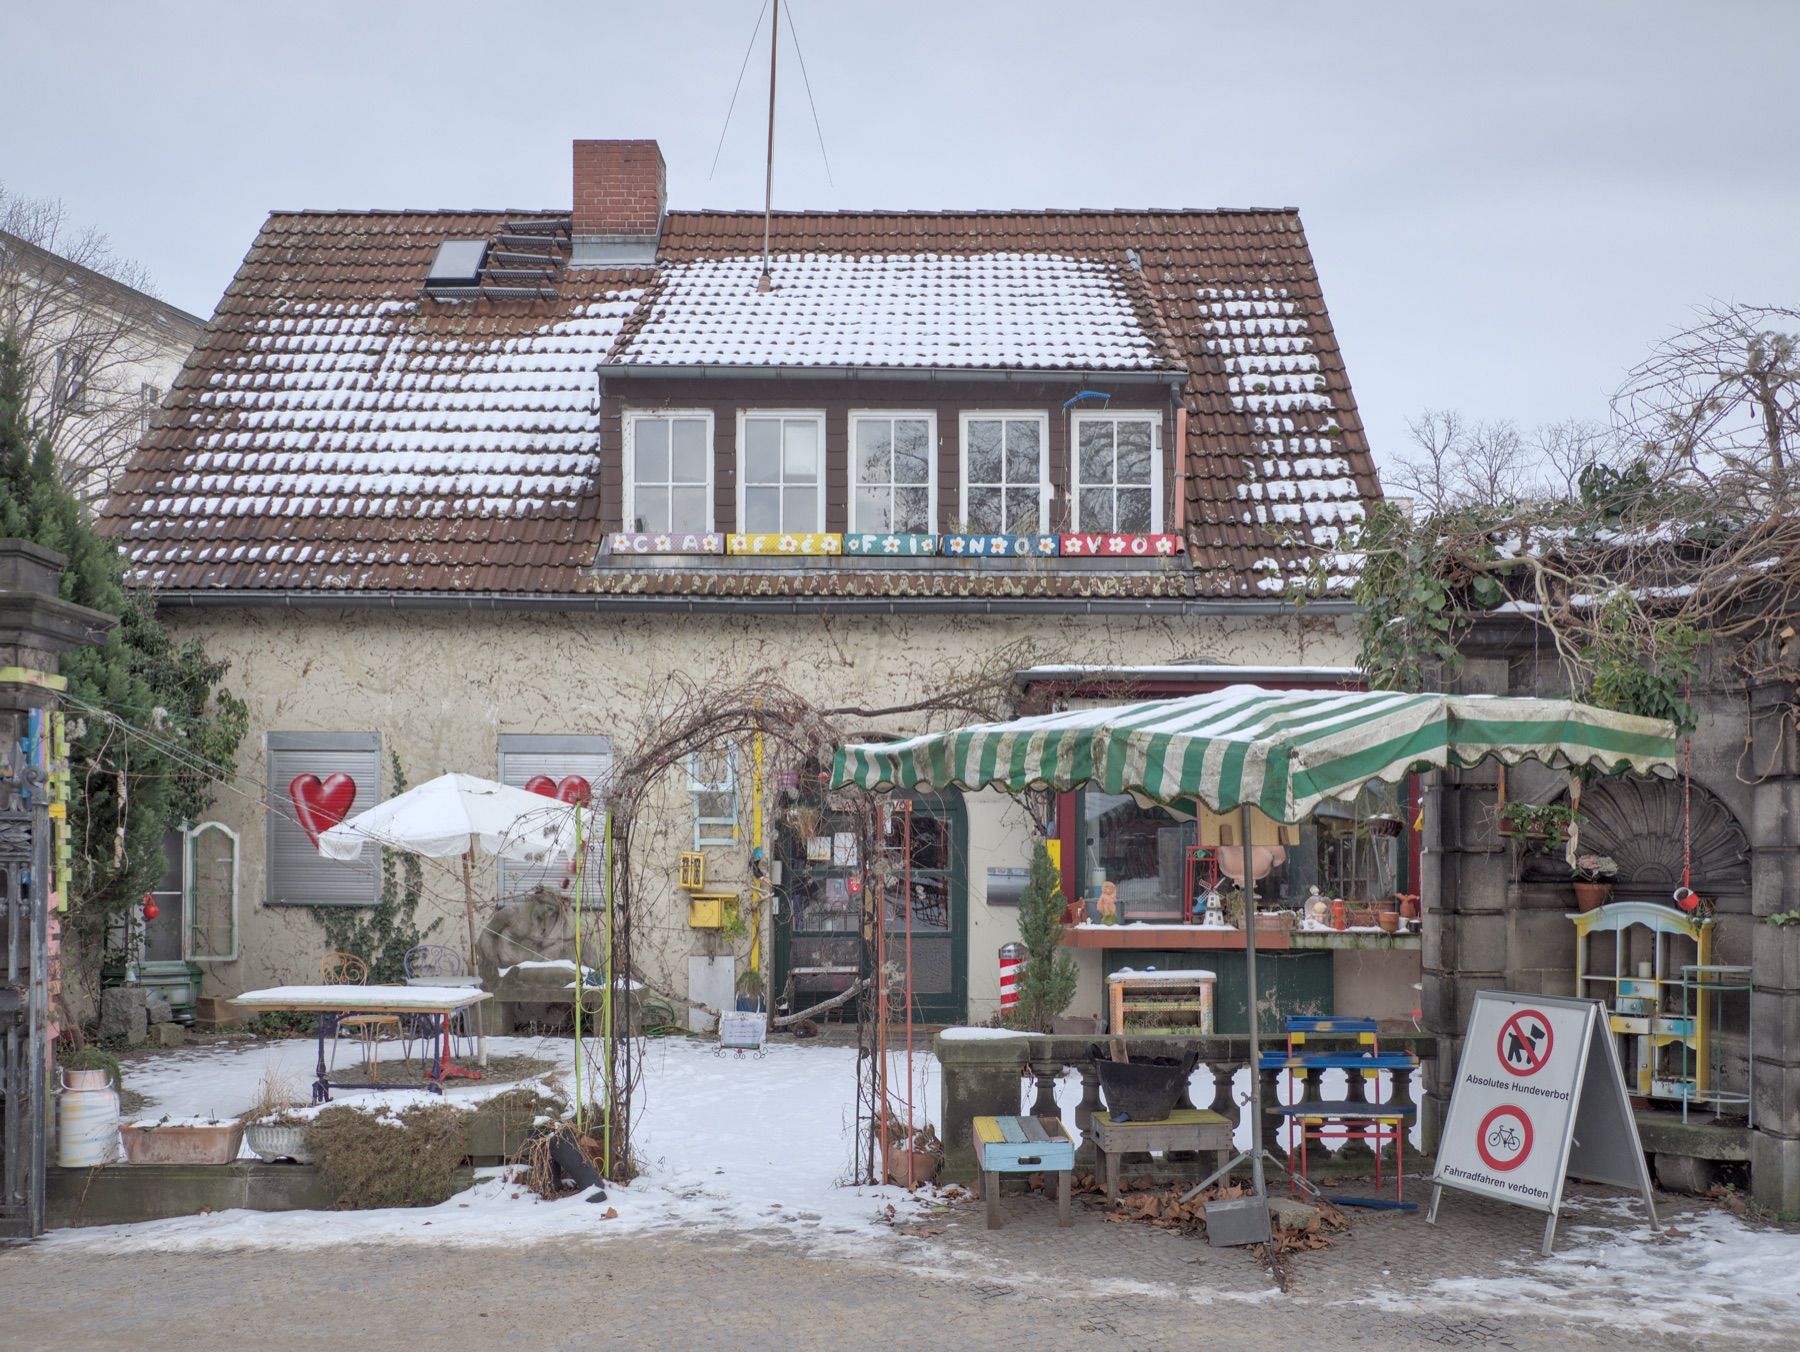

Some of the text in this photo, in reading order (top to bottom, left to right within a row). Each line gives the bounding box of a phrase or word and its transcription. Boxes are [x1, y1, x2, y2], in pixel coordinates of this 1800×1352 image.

[862, 534, 1148, 554] FINOVO
[1466, 1074, 1570, 1101] Absolutes Hundeverbot
[1443, 1165, 1549, 1199] Fahrradfahren verboten
